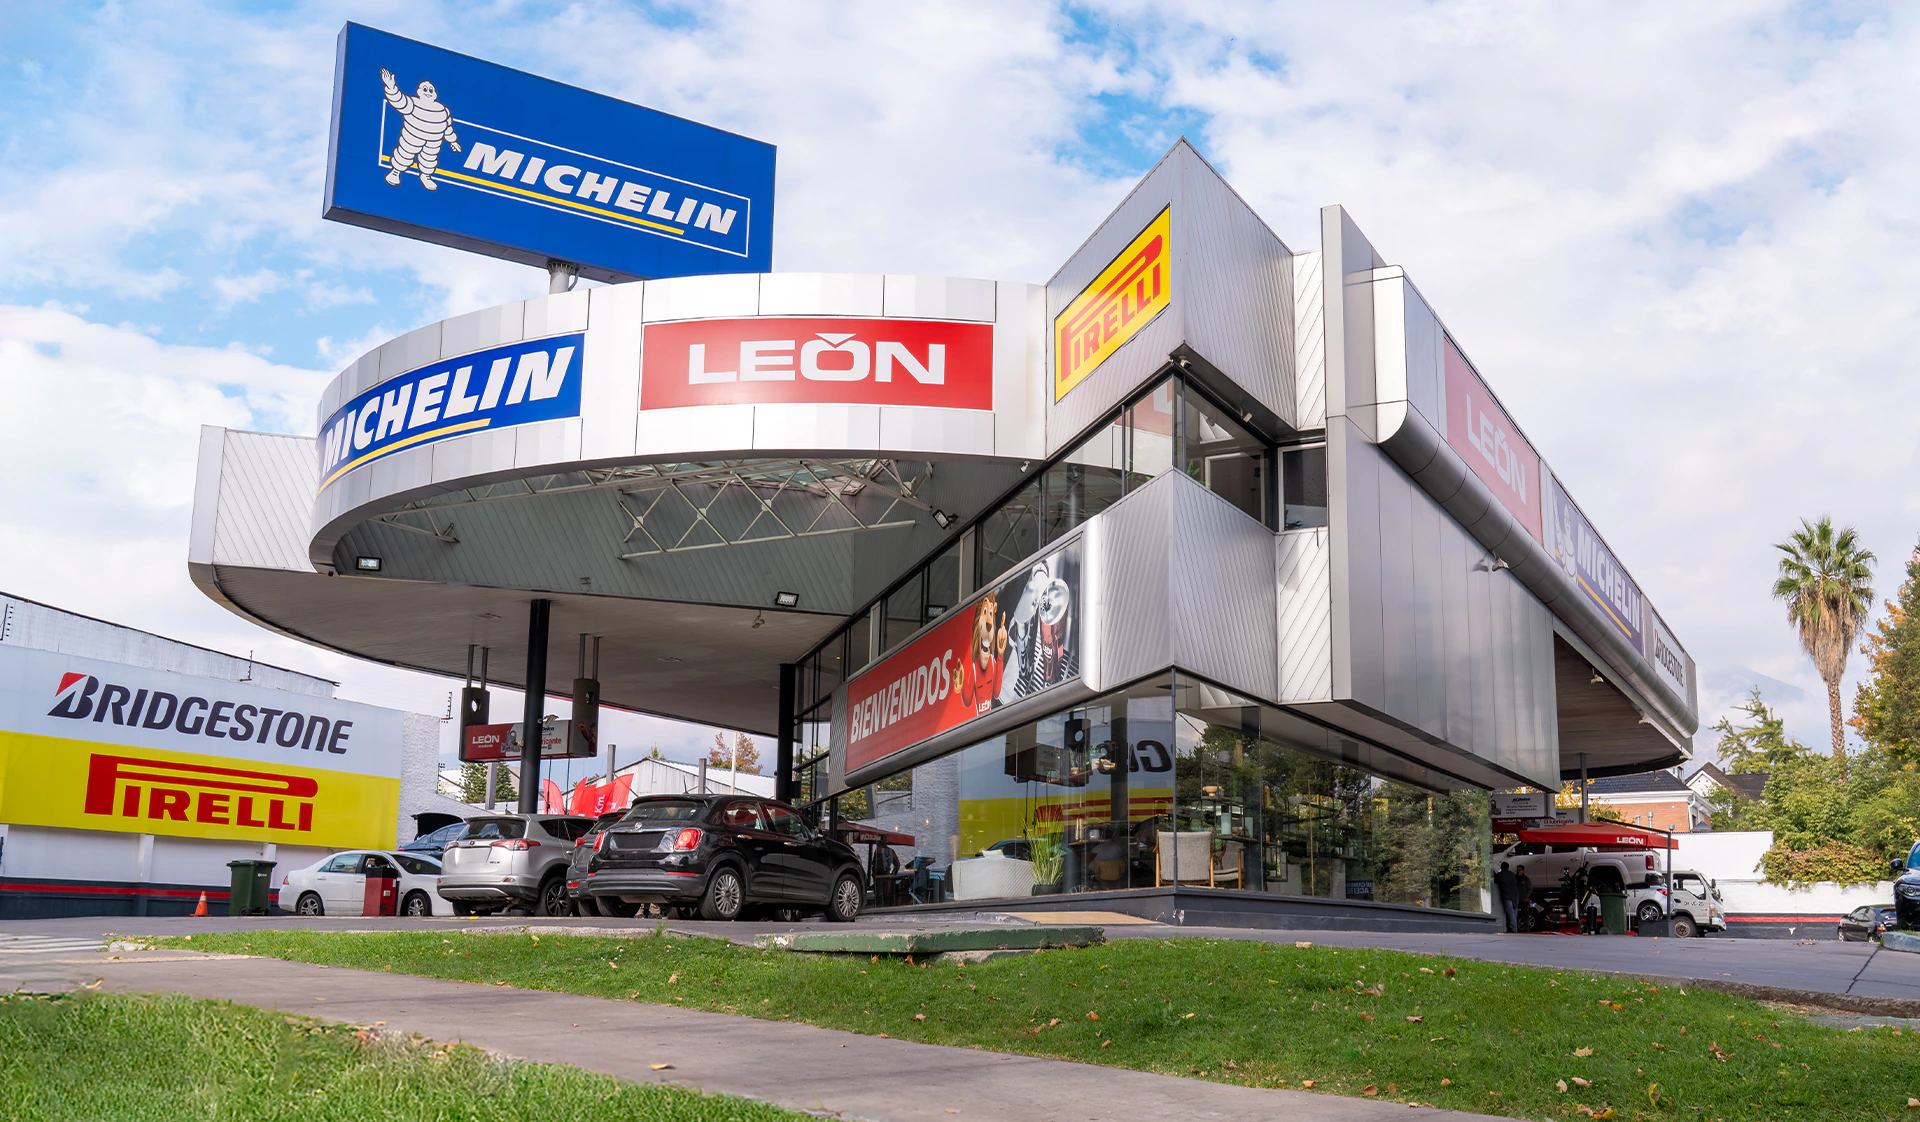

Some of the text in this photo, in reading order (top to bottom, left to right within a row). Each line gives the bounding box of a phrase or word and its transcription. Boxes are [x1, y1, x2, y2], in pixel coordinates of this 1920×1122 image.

[464, 142, 737, 235] MICHELIN
[1060, 234, 1163, 384] PIRELLI
[322, 346, 575, 479] MICHELIN
[1577, 521, 1640, 633] MICHELIN
[47, 671, 354, 756] BRIDGESTONE
[850, 648, 953, 744] BIENVENIDOS
[84, 753, 319, 832] PIRELLI
